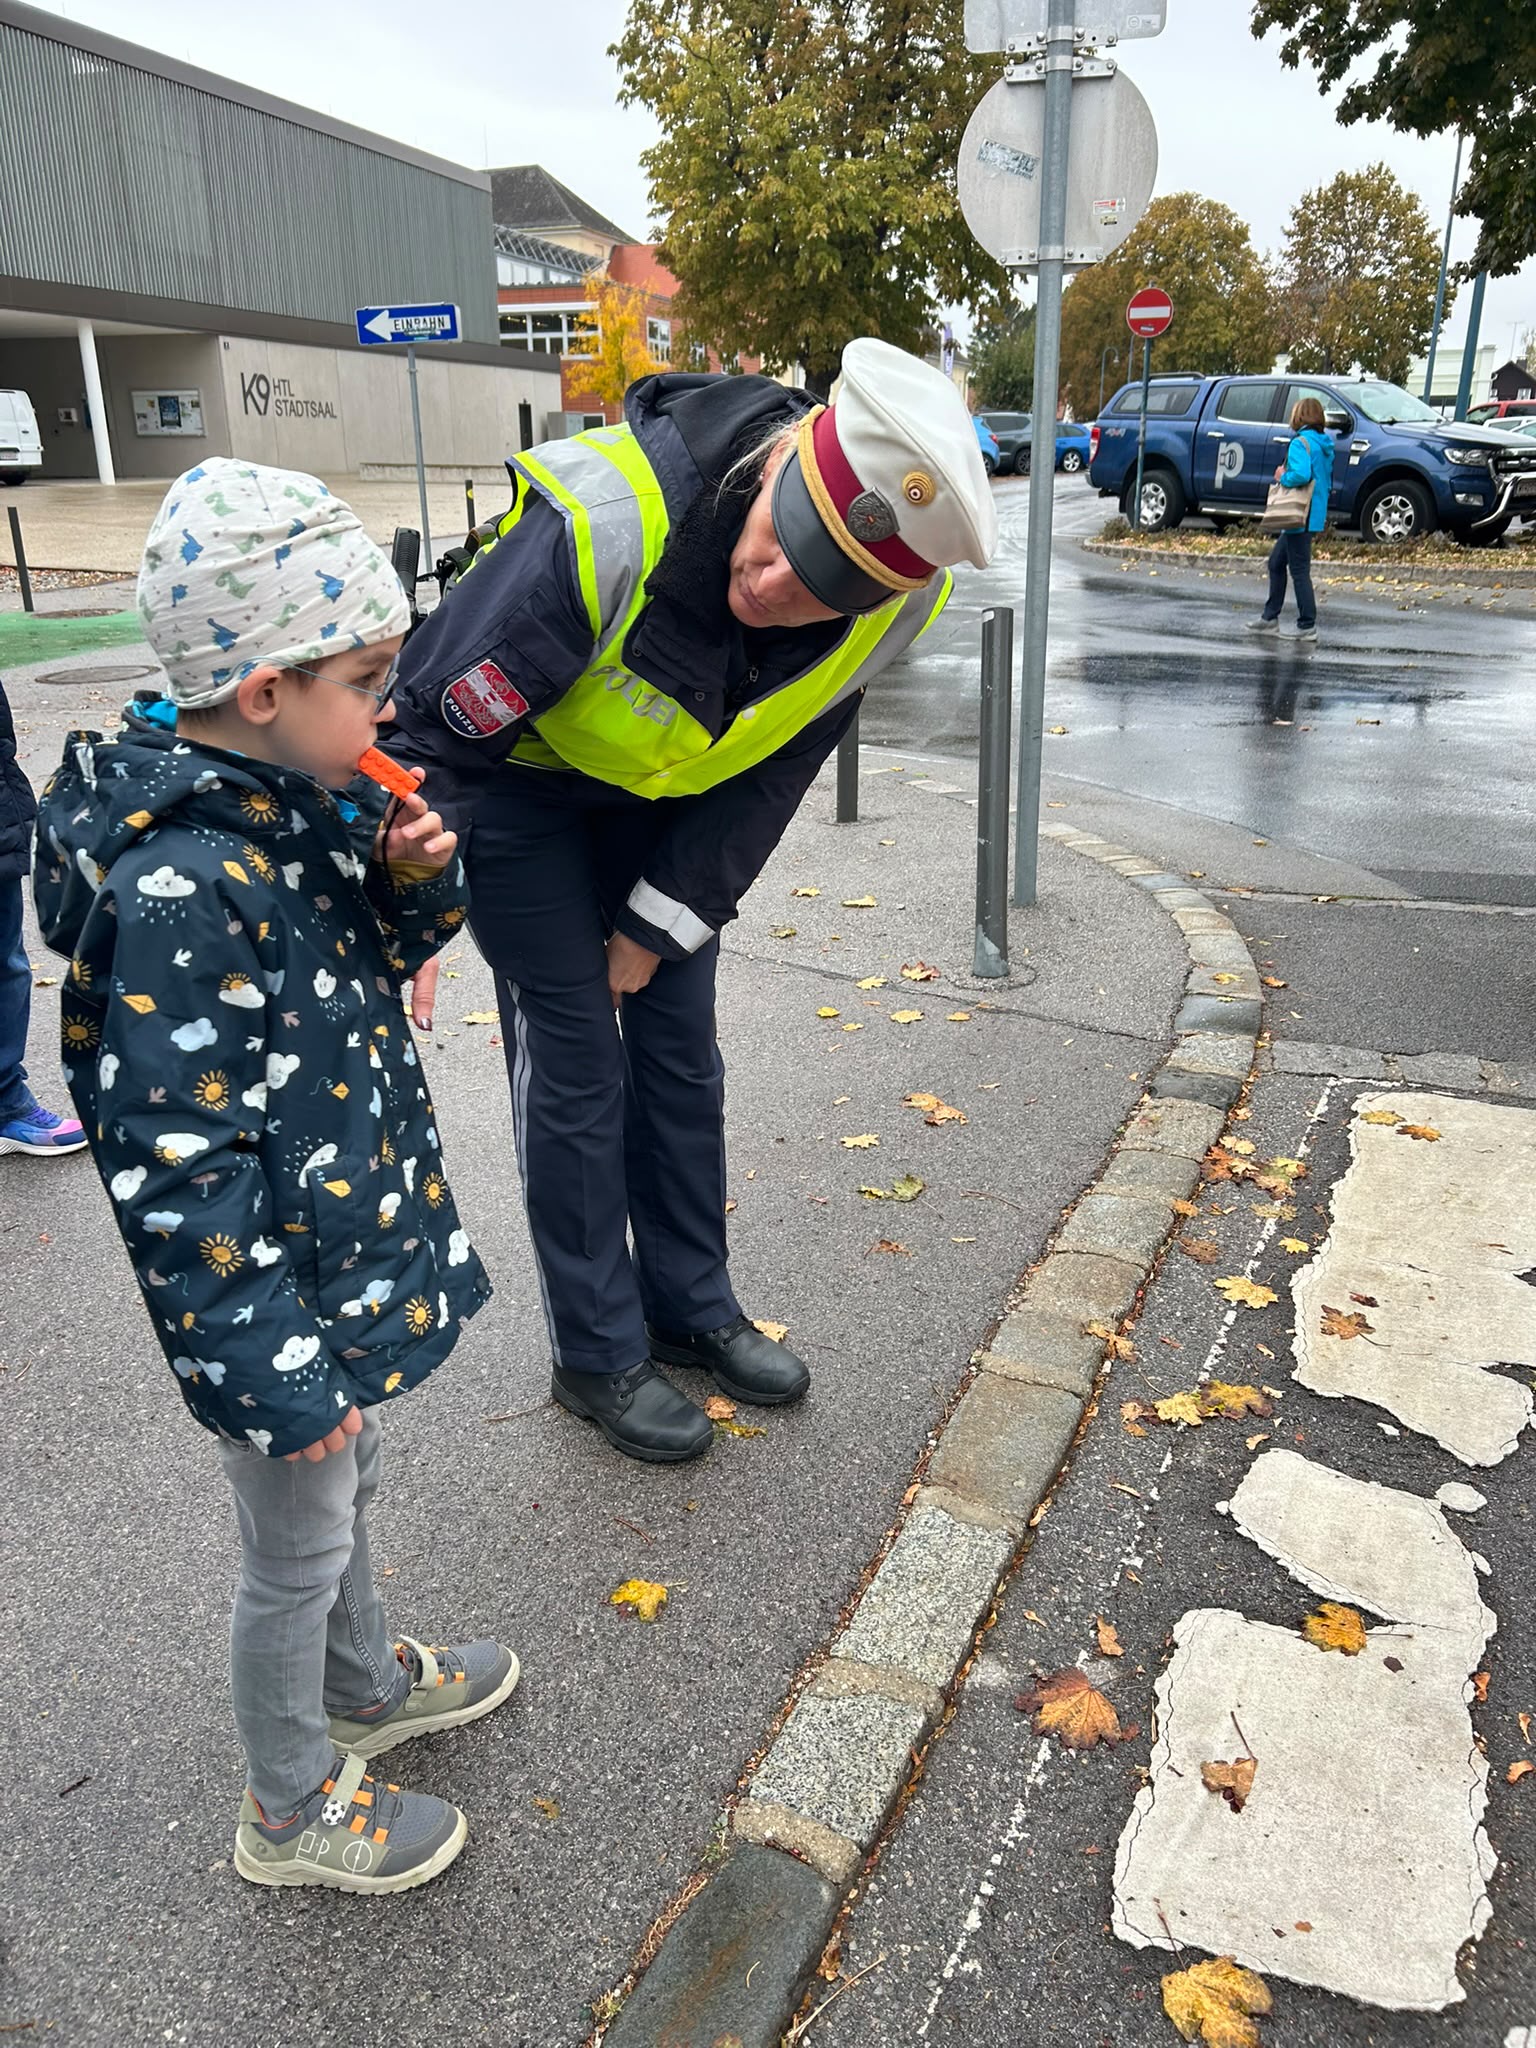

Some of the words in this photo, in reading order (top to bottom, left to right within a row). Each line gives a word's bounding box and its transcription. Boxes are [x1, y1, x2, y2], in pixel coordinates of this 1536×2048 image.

[241, 372, 270, 416] K9
[273, 378, 295, 397] HTL
[275, 399, 337, 419] STADTSAAL
[445, 697, 479, 735] POLIZEI
